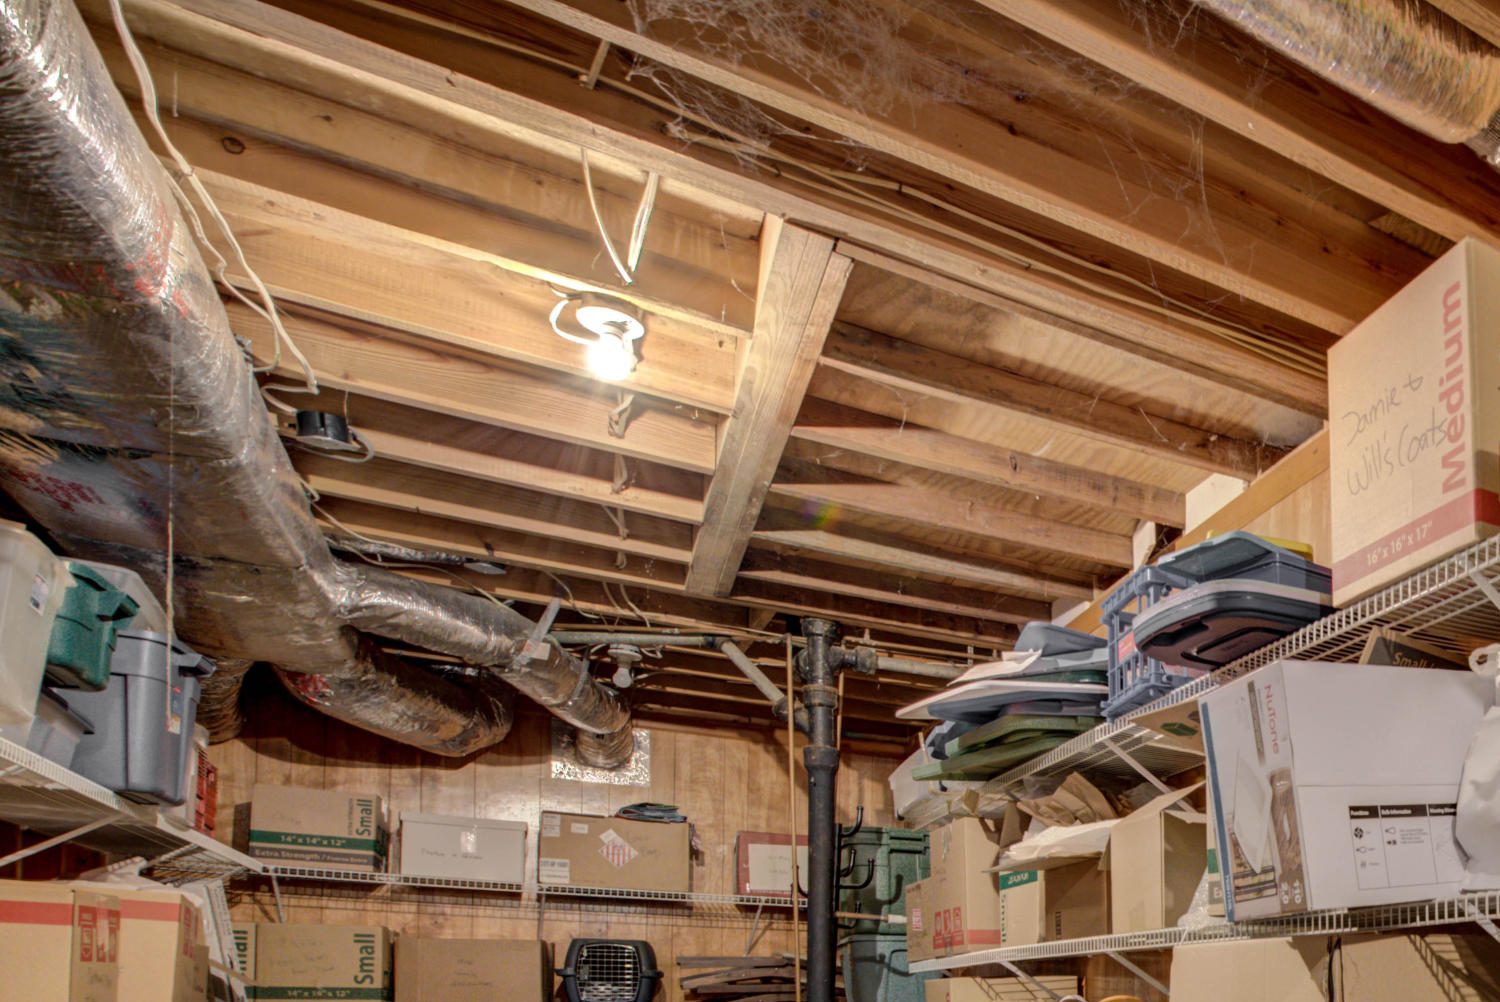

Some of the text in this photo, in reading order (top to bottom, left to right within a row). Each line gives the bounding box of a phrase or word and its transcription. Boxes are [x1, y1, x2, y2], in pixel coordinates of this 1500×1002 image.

[1439, 280, 1467, 496] Medium
[355, 799, 373, 836] Small
[353, 933, 375, 985] Small
